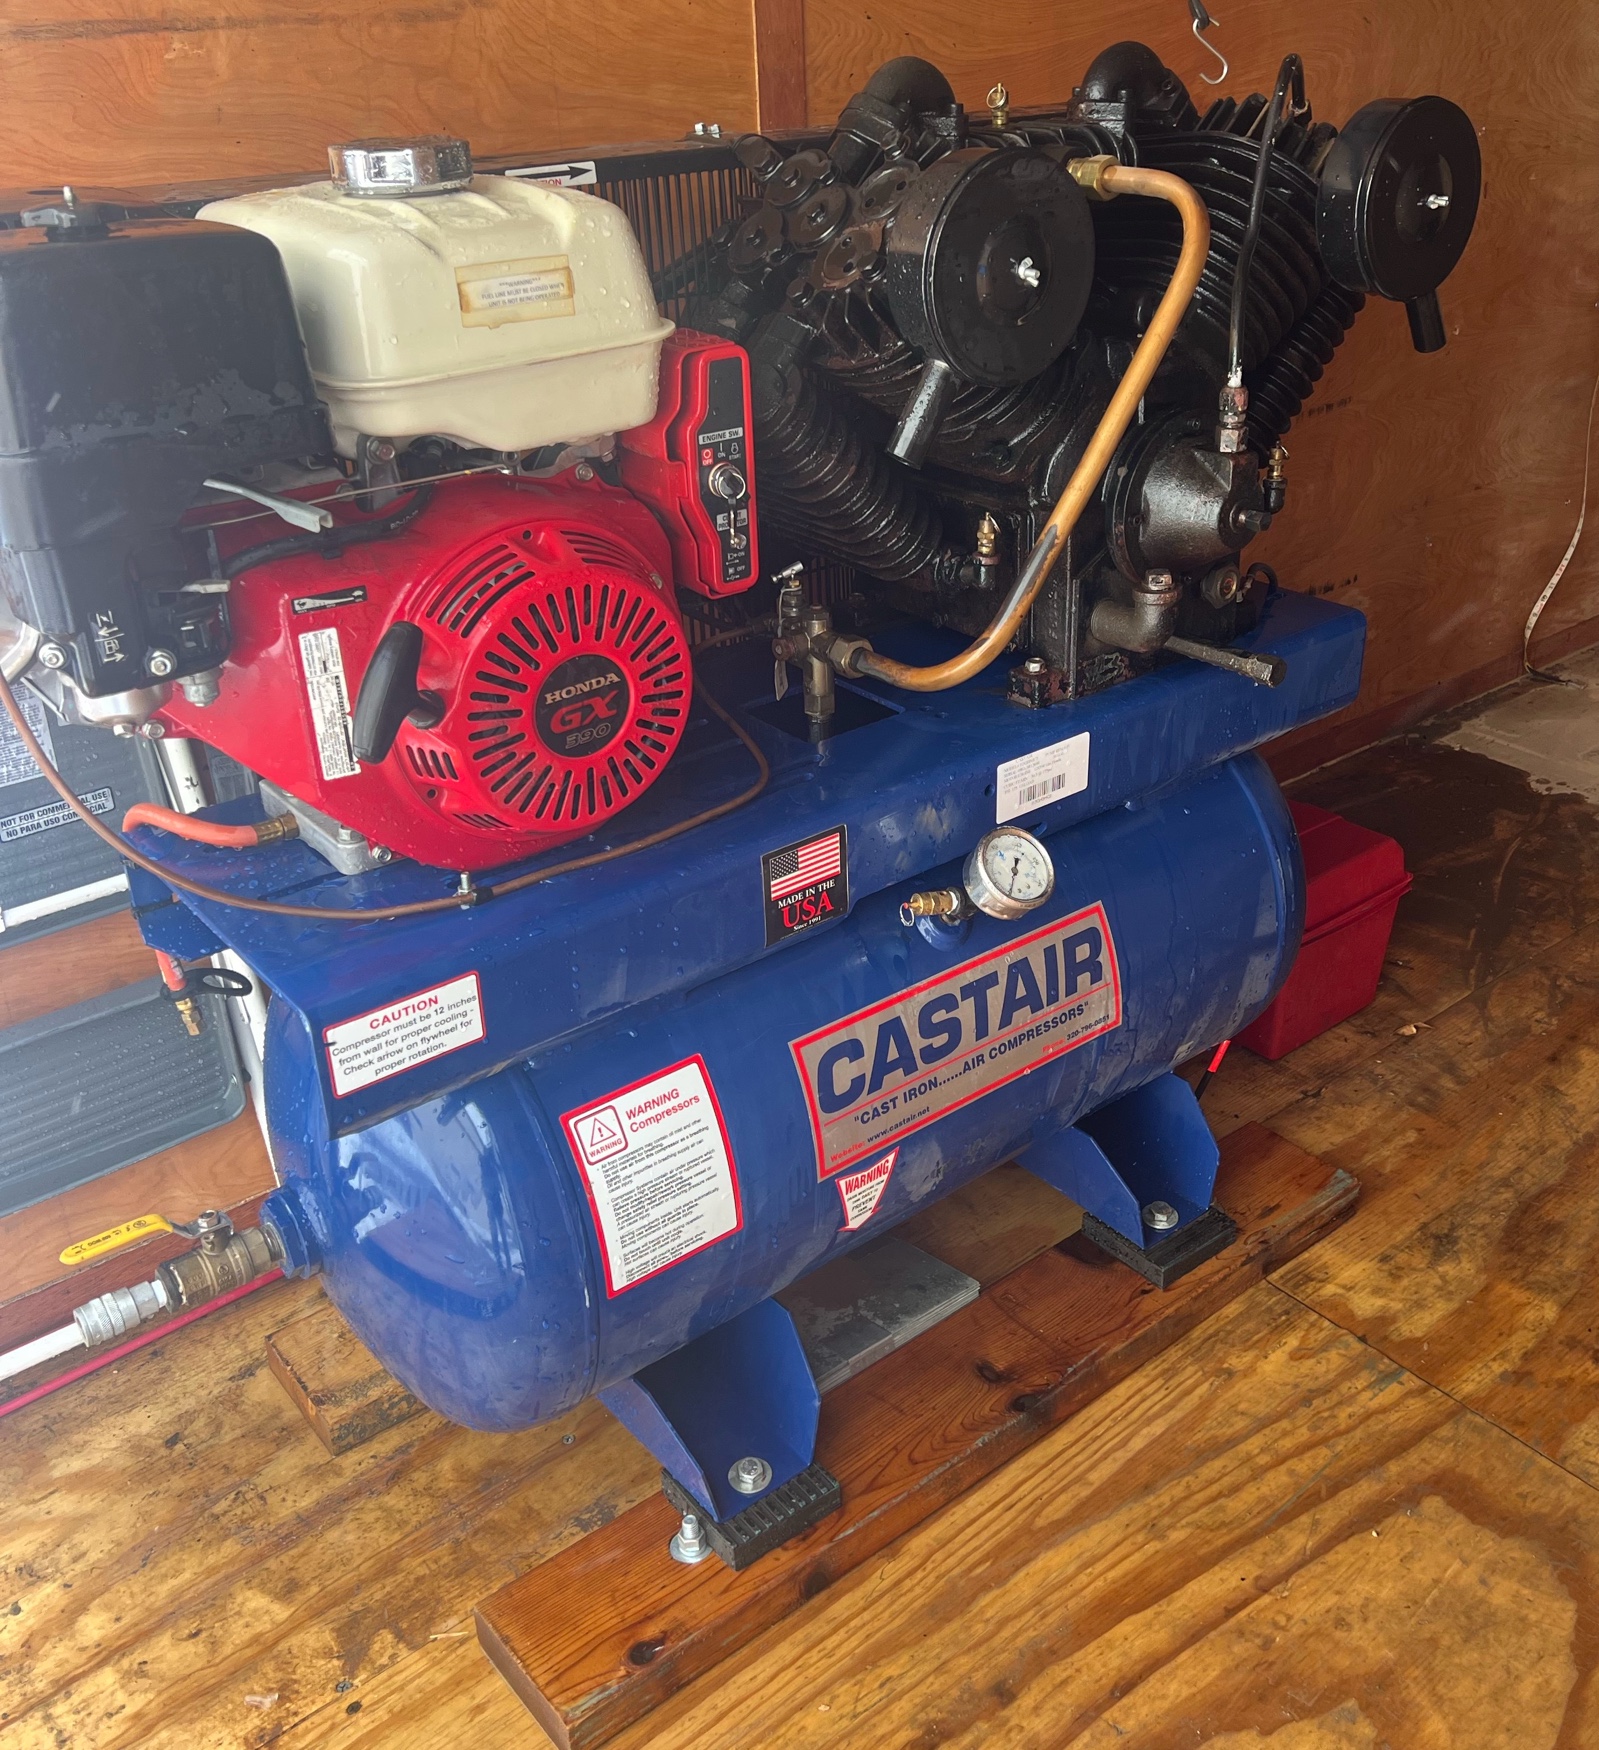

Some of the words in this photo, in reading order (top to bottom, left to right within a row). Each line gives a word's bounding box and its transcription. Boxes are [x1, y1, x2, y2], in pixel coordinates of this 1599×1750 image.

[702, 432, 727, 443] ENGINE
[544, 673, 621, 704] HONDA
[550, 690, 619, 734] GX
[565, 722, 611, 749] 390
[0, 818, 17, 829] NOT
[19, 810, 36, 823] FOR
[92, 791, 108, 800] USE
[6, 829, 18, 838] NO
[21, 821, 42, 835] PARA
[45, 817, 60, 826] USO
[778, 892, 804, 909] MADE
[806, 886, 816, 897] IN
[817, 879, 835, 892] THE
[782, 891, 834, 927] USA
[794, 923, 807, 931] Since
[332, 1027, 391, 1057] Compressor
[393, 1019, 417, 1033] must
[419, 1012, 432, 1023] be
[434, 1006, 444, 1016] 12
[448, 995, 477, 1011] inches
[369, 995, 438, 1030] CAUTION
[817, 926, 1103, 1115] CASTAIR
[339, 1053, 361, 1066] from
[364, 1044, 383, 1057] wall
[385, 1038, 398, 1048] for
[401, 1026, 432, 1042] proper
[434, 1009, 468, 1028] cooling
[343, 1059, 375, 1076] Check
[377, 1048, 403, 1063] arrow
[421, 1023, 458, 1047] flywheel
[460, 1018, 473, 1029] for
[375, 1058, 406, 1076] proper
[408, 1042, 447, 1062] rotation.
[625, 1088, 680, 1121] WARNING
[630, 1095, 700, 1134] Compressors
[589, 1138, 623, 1158] WARNING
[830, 1141, 865, 1162] Website:
[867, 1106, 930, 1143] www.castair.net
[845, 1159, 889, 1195] WARNING
